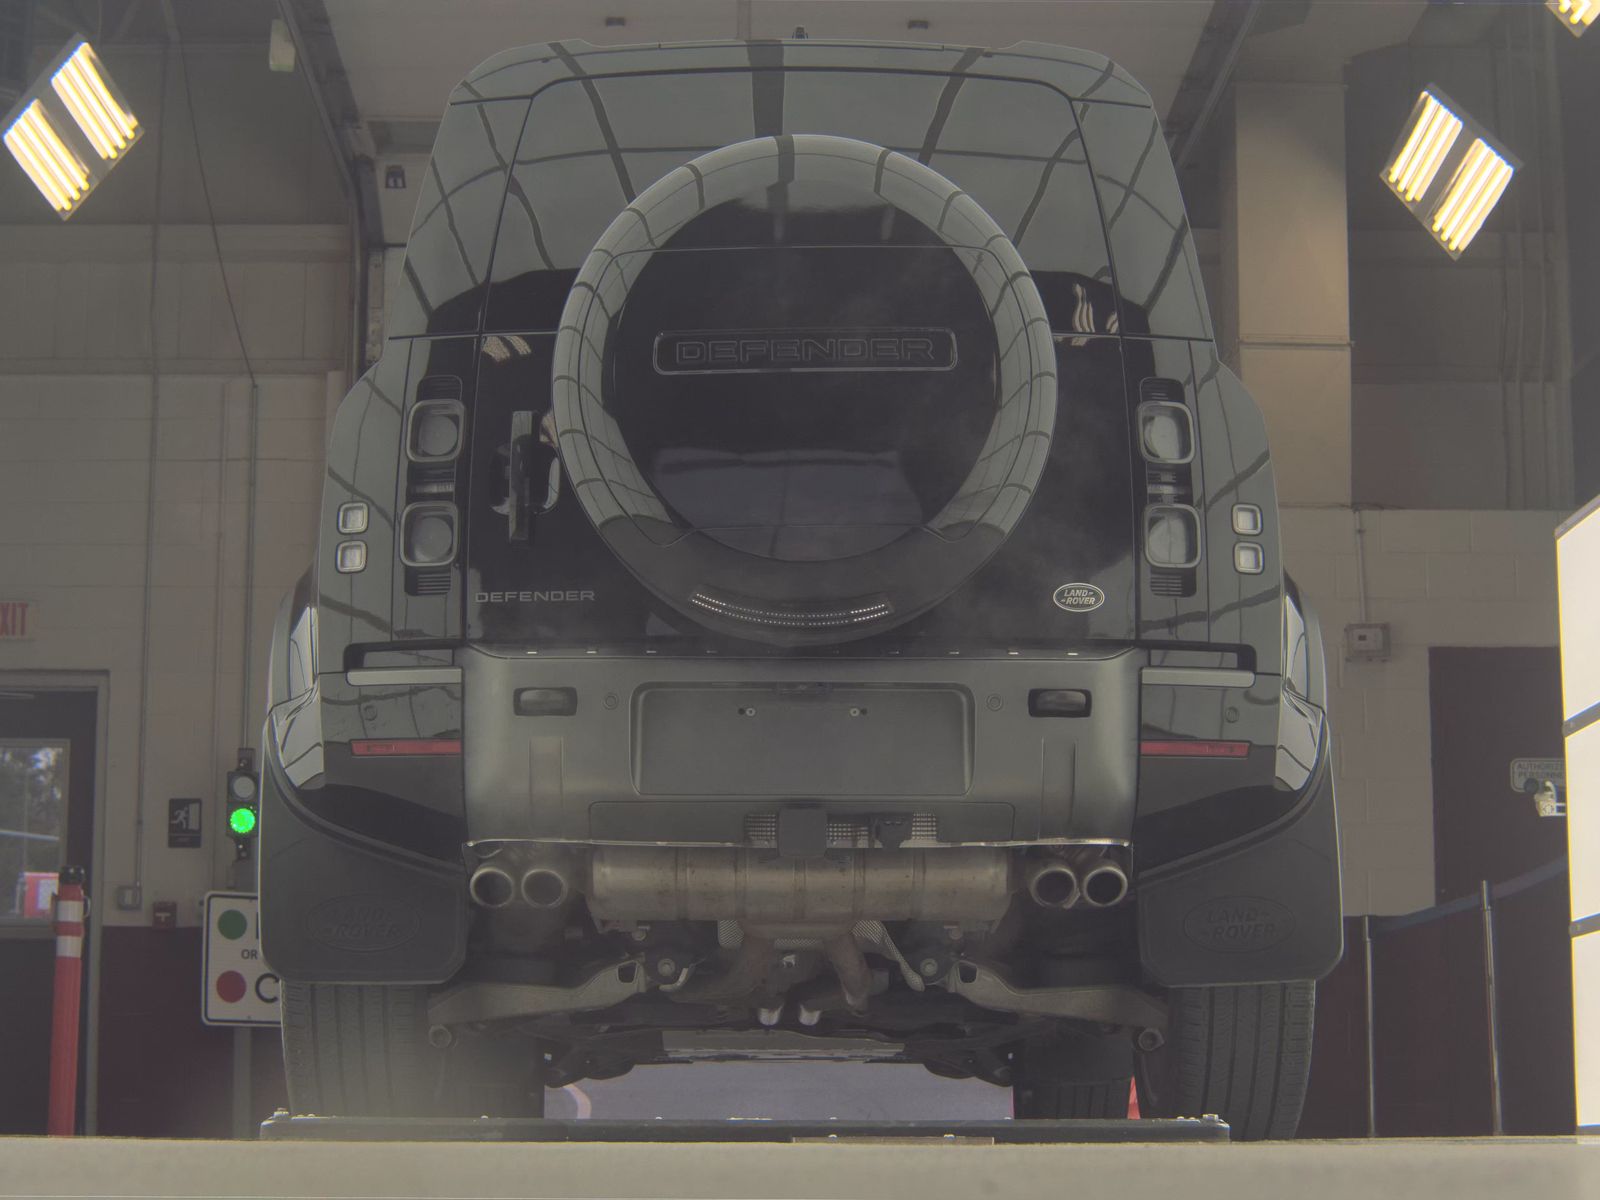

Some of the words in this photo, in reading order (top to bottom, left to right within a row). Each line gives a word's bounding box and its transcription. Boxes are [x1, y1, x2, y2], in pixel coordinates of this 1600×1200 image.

[675, 337, 936, 364] DEFENDER
[475, 590, 596, 603] DEFENDER
[0, 602, 29, 636] XIT
[240, 948, 258, 961] OR
[254, 972, 280, 1004] C
